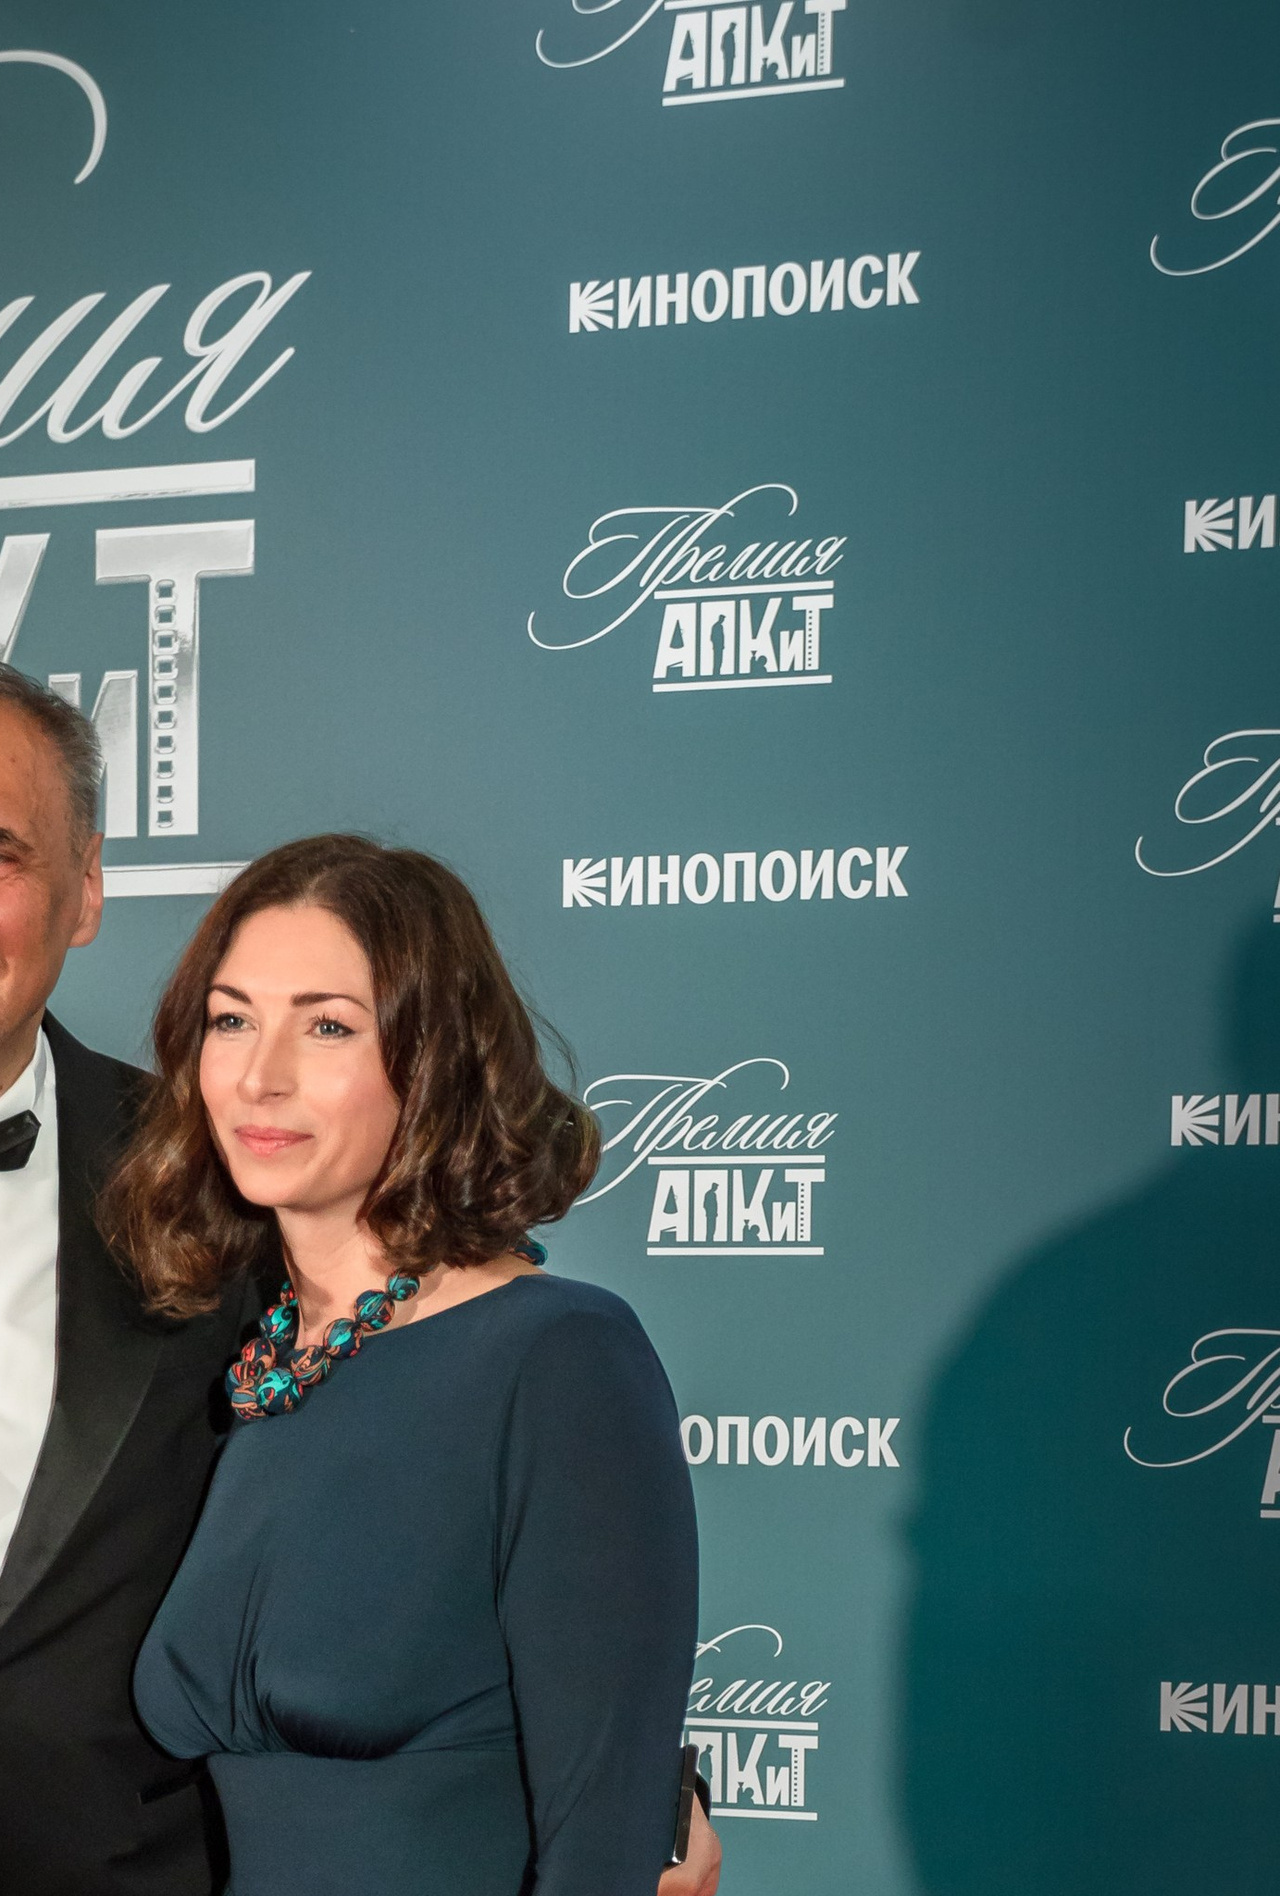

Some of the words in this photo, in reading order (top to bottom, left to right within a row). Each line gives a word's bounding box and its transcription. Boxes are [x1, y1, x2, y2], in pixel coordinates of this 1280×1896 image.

[568, 249, 922, 334] КИНОПОИСК
[527, 483, 849, 651] Премия
[561, 845, 910, 909] КИНОПОИСК
[571, 1056, 840, 1210] Премия
[679, 1414, 902, 1469] ОПОИСК
[681, 1730, 820, 1808] ПКиТ
